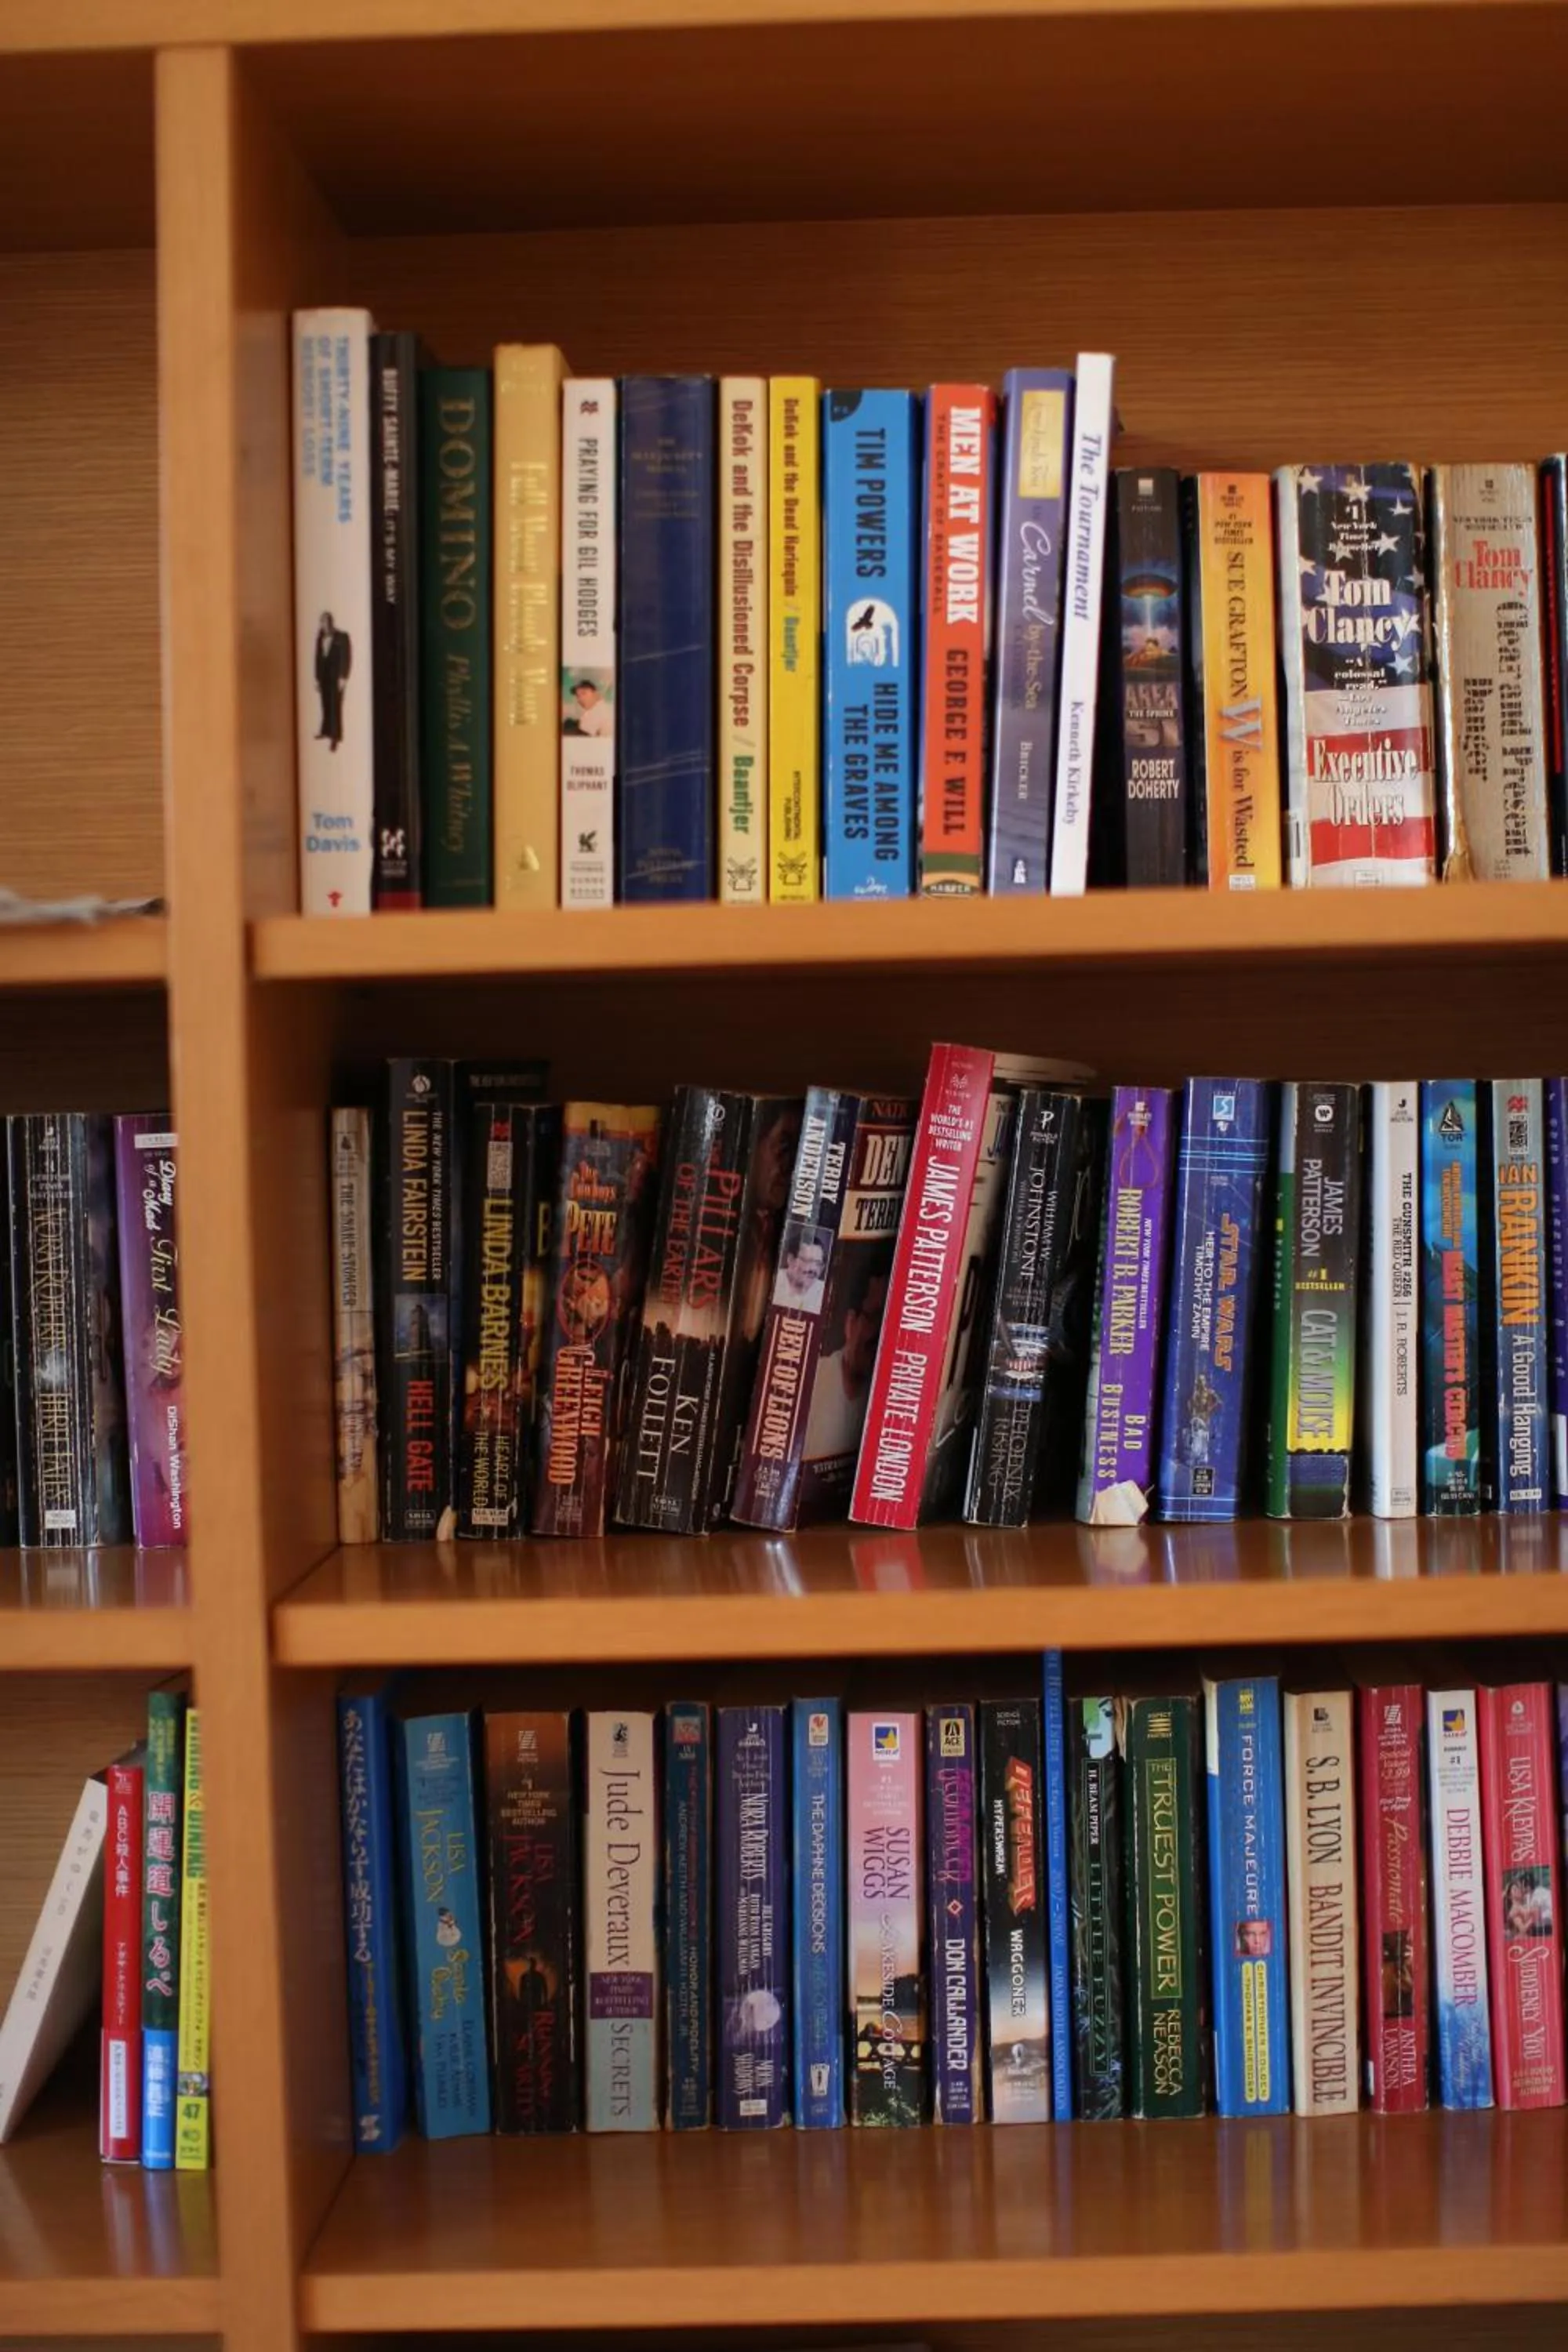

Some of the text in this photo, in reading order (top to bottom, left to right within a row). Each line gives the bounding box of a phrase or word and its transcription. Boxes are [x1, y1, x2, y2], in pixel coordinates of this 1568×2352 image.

[731, 400, 753, 457] DeKok
[1078, 432, 1104, 477] The
[437, 396, 477, 630] DOMINO
[731, 463, 753, 498] and
[855, 427, 887, 579] TIM POWERS
[576, 437, 599, 638] PRAYING FOR GIL HODGES
[731, 504, 753, 533] the
[945, 406, 983, 625] MEN AT WORK
[1018, 521, 1054, 626] Carmel
[1072, 483, 1100, 622] Tournament
[1226, 551, 1245, 592] SUE
[1472, 539, 1523, 568] Tom
[731, 539, 753, 656] Disillusioned
[1323, 570, 1392, 607] Tom
[1226, 596, 1249, 698] GRAFTON
[1306, 607, 1414, 652] Clancy
[729, 662, 755, 728] Corpse
[843, 704, 869, 841] THE GRAVES
[873, 683, 900, 862] HIDE ME AMONG
[942, 648, 970, 837] GEORGE WILL
[1131, 758, 1175, 779] ROBERT
[1312, 737, 1418, 783] Executive
[313, 811, 354, 830] Tom
[1127, 779, 1180, 800] DOHERTY
[1330, 783, 1405, 827] Orders
[306, 834, 361, 853] Davis
[1234, 793, 1256, 868] Wasted
[401, 1110, 428, 1172] LINDA
[791, 1116, 828, 1218] ANDERSON
[818, 1142, 847, 1206] TERRY
[1498, 1163, 1538, 1185] IAN
[677, 1163, 698, 1191] OF
[1301, 1158, 1324, 1258] PATTERSON
[1322, 1177, 1344, 1236] JAMES
[401, 1178, 427, 1281] FAIRSTEIN
[482, 1197, 514, 1277] LINDA
[670, 1196, 691, 1232] THE
[686, 1167, 742, 1308] PILLARS
[1402, 1172, 1413, 1268] THE GUNSMITH
[1109, 1187, 1144, 1356] ROBERT B. PARKER
[1392, 1240, 1403, 1261] RED
[1392, 1263, 1403, 1298] QUEEN
[1215, 1213, 1241, 1371] STAR WARS
[479, 1283, 511, 1391] BARNES
[775, 1318, 808, 1363] DEN
[870, 1156, 960, 1503] JAMES PATTERSON PRIVATE LONDON
[1300, 1308, 1338, 1348] CAT
[1499, 1188, 1541, 1478] RANKIN A Good Hanging
[406, 1380, 434, 1434] HELL
[547, 1344, 596, 1485] GREENWOOD
[771, 1365, 800, 1396] OF
[636, 1354, 677, 1484] FOLLETT
[670, 1394, 700, 1456] KEN
[758, 1395, 793, 1461] LIONS
[1097, 1383, 1124, 1479] BUSINESS
[1123, 1414, 1147, 1450] BAD
[406, 1439, 436, 1493] GATE
[493, 1436, 512, 1499] HEART OF
[597, 1769, 644, 1831] Jude
[740, 1792, 768, 1828] NORA
[811, 1794, 825, 1820] THE
[1305, 1777, 1340, 1802] B.
[1503, 1755, 1537, 1864] LISA KLEYPAS
[739, 1829, 768, 1880] ROBERTS
[1240, 1734, 1258, 1916] FORCE MAJEURE
[1305, 1806, 1342, 1865] LYON
[1446, 1808, 1474, 1881] DEBBIE
[863, 1827, 887, 1900] WIGGS
[887, 1826, 910, 1900] SUSAN
[1152, 1774, 1178, 1991] TRUEST POWER
[606, 1842, 641, 1966] Deveraux
[1307, 1883, 1347, 1969] BANDIT
[1449, 1888, 1479, 2009] MACOMBER
[945, 1938, 967, 2070] DON CALLANDER
[1507, 1944, 1551, 2024] SUDDENLY
[609, 2023, 633, 2118] SECRETS
[1152, 2012, 1169, 2094] NEASON
[1166, 2009, 1183, 2096] REBECCA
[1309, 1974, 1348, 2104] INVINCIBLE
[1383, 2027, 1400, 2089] LAWSON
[1400, 2027, 1417, 2087] ANTHEA
[1522, 2027, 1546, 2060] YOU
